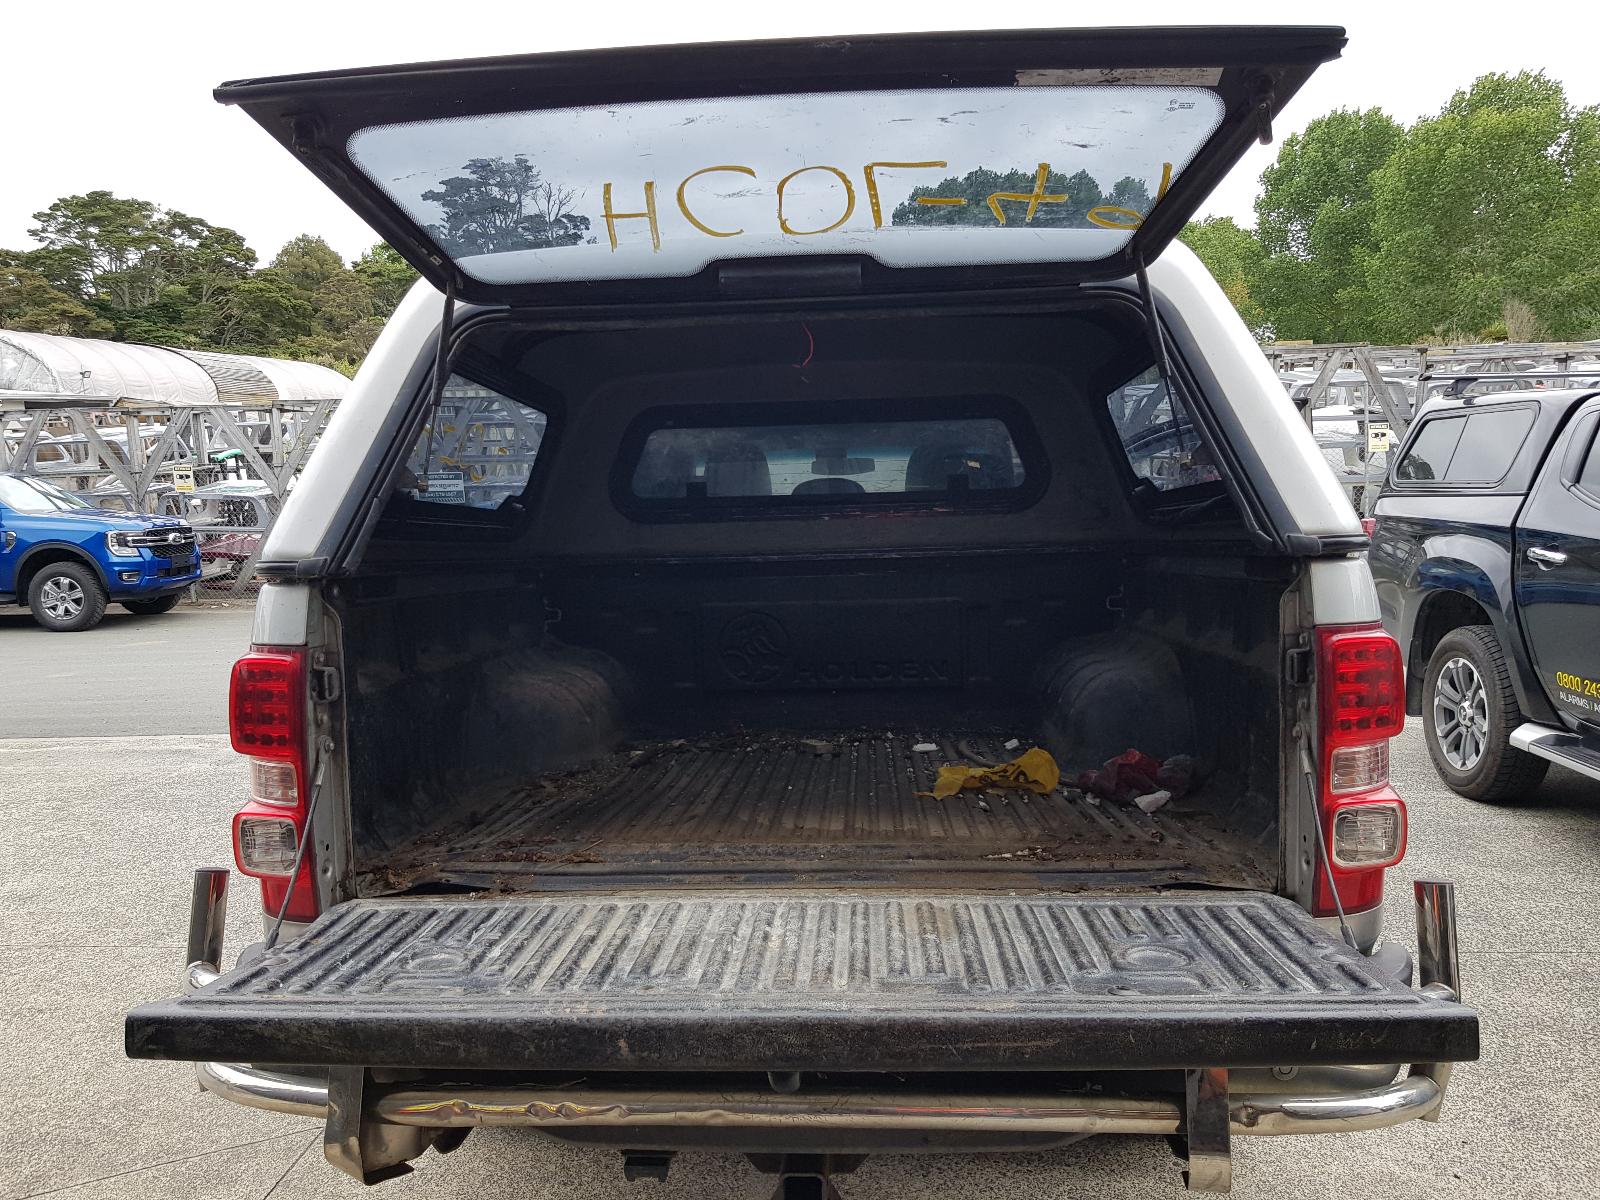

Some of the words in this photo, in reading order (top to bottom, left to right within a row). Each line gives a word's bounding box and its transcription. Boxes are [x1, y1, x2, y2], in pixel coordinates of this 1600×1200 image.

[792, 659, 949, 684] HOLDEN
[1556, 671, 1581, 692] 0800
[1560, 691, 1589, 709] ALARMS
